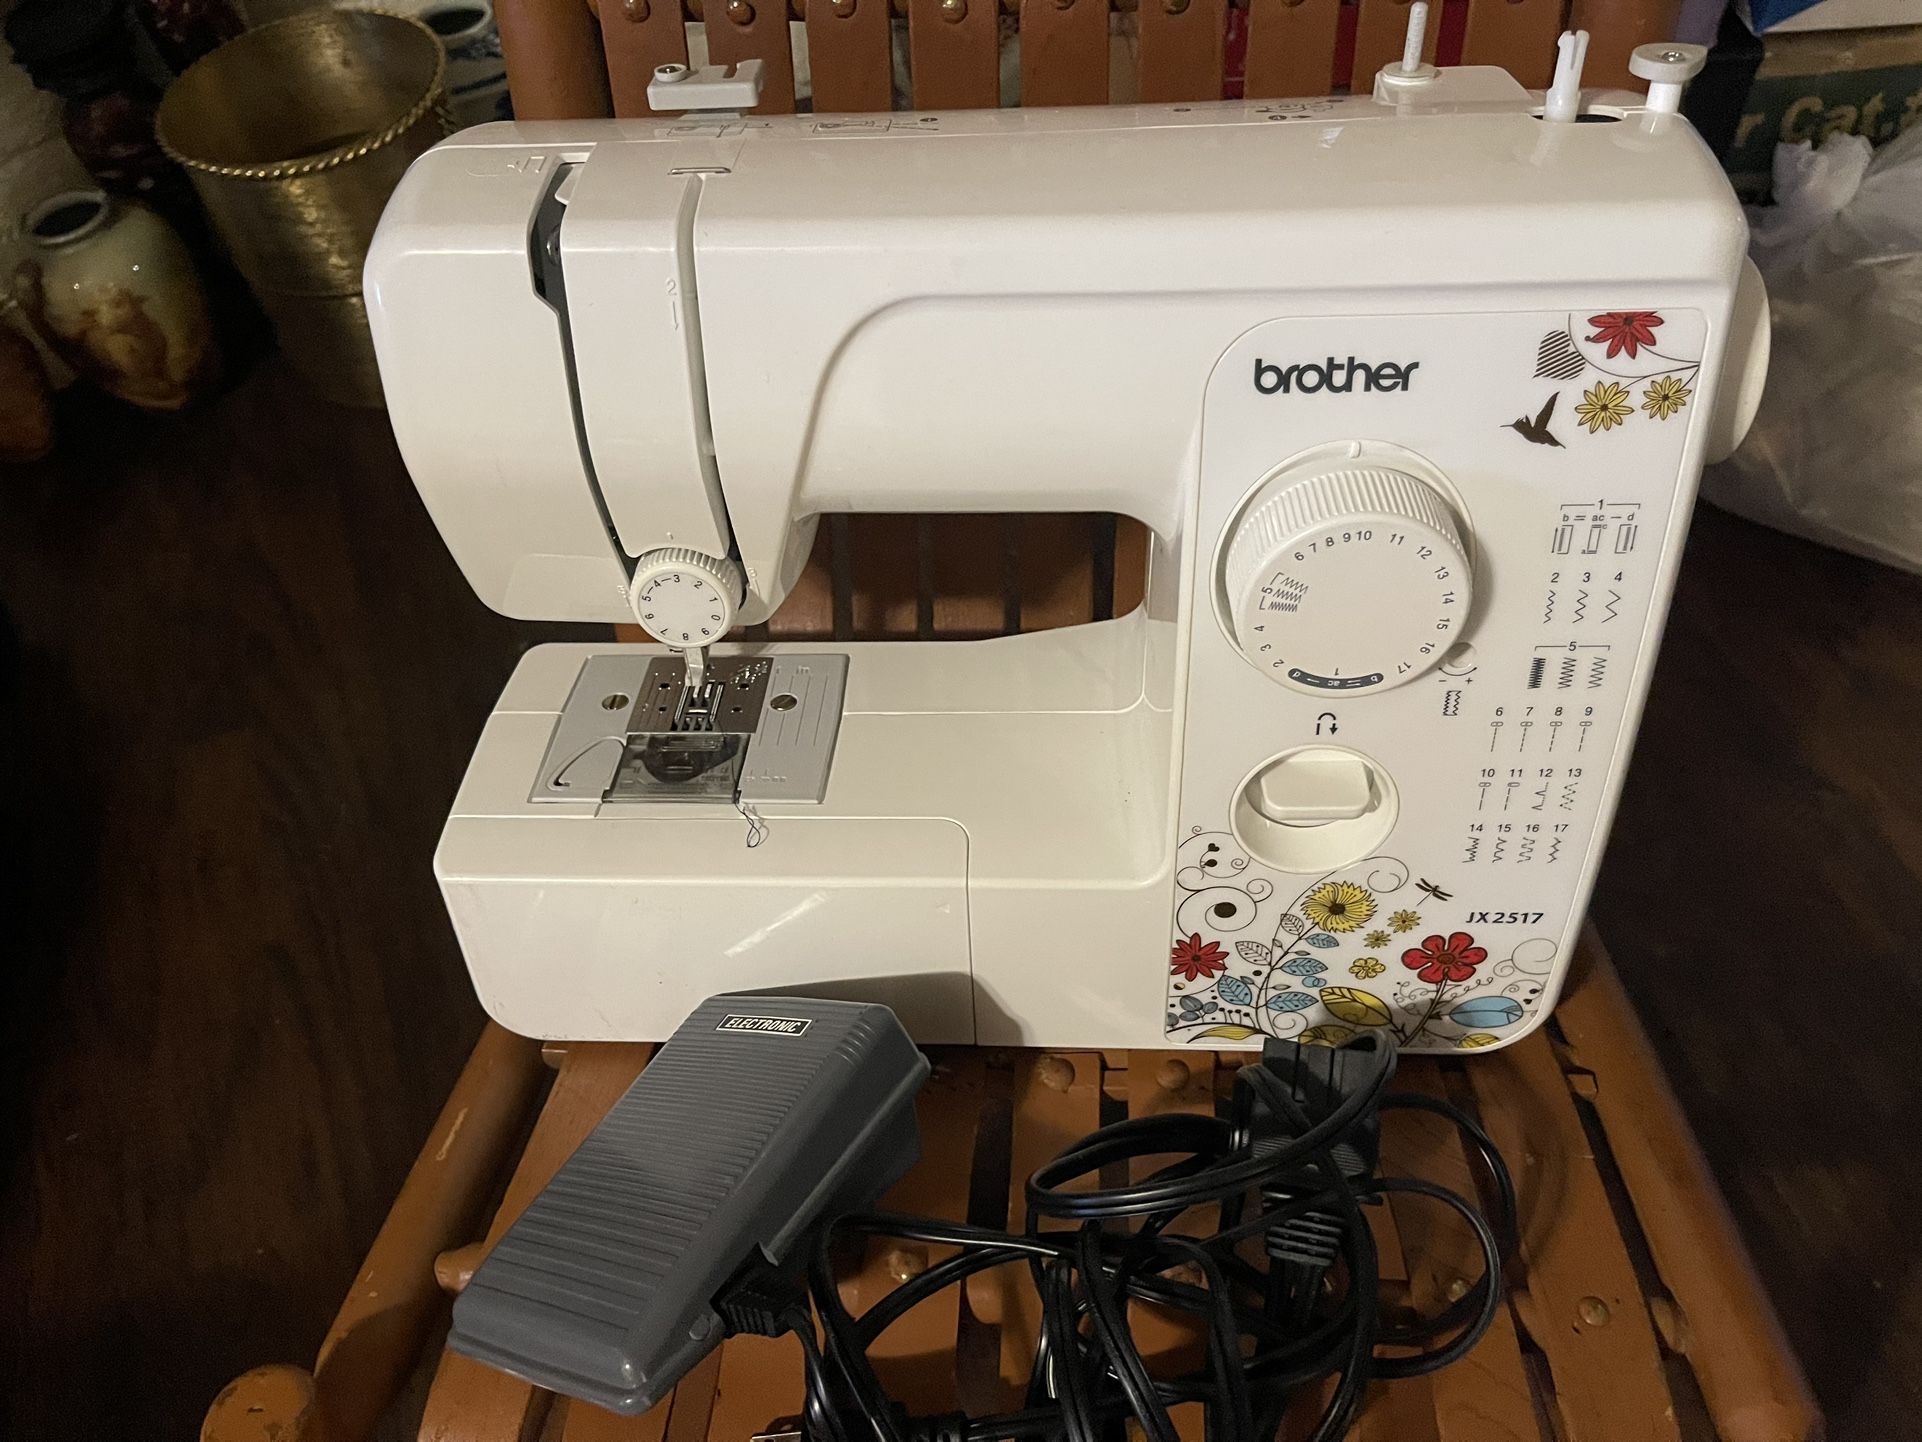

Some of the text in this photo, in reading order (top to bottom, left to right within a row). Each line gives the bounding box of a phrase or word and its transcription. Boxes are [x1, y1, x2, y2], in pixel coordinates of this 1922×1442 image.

[665, 277, 677, 296] 2
[1254, 356, 1420, 395] brother
[1598, 499, 1604, 510] 1
[1562, 512, 1634, 522] b ac d
[1342, 532, 1351, 543] 9
[1356, 530, 1372, 541] 10
[1389, 533, 1405, 546] 11
[1325, 536, 1335, 547] 8
[1308, 542, 1318, 553] 7
[1294, 551, 1305, 561] 6
[1416, 546, 1432, 560] 12
[1434, 566, 1449, 580] 13
[1550, 571, 1623, 583] 2 3 4
[654, 579, 662, 588] 4
[673, 574, 681, 583] 3
[693, 580, 703, 590] 2
[1261, 586, 1273, 595] 5
[641, 594, 652, 602] 5
[1442, 591, 1455, 604] 14
[1436, 618, 1450, 630] 15
[660, 627, 669, 636] 7
[682, 632, 689, 641] 8
[701, 627, 710, 636] 9
[1260, 643, 1272, 652] 3
[1420, 642, 1435, 654] 16
[1568, 641, 1577, 651] 5
[1272, 659, 1285, 669] 2
[1397, 661, 1412, 675] 17
[1334, 667, 1340, 676] 1
[1496, 706, 1593, 716] 6 7 8 9
[1481, 768, 1583, 778] 10 11 12 13
[1469, 824, 1569, 833] 14 15 16 17
[1465, 912, 1544, 924] JX2517
[724, 1018, 802, 1033] ELECTRONIC
